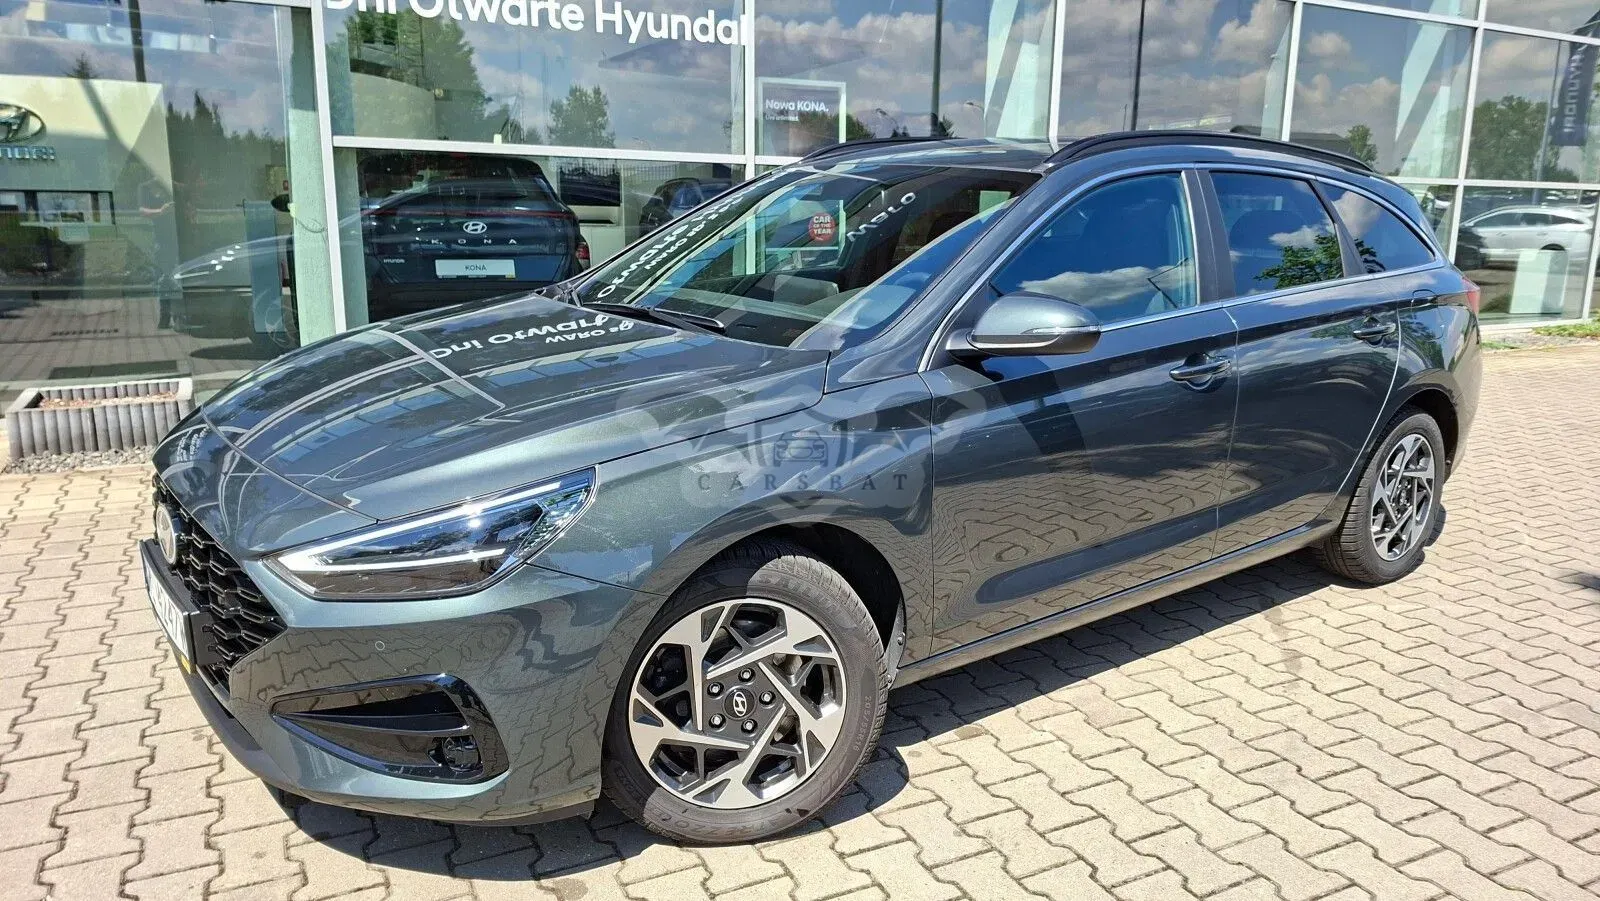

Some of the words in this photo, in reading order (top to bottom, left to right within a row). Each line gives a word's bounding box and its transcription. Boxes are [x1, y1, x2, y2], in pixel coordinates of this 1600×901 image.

[765, 99, 796, 111] Nowa
[797, 100, 829, 112] KONA.
[465, 264, 488, 272] KONA
